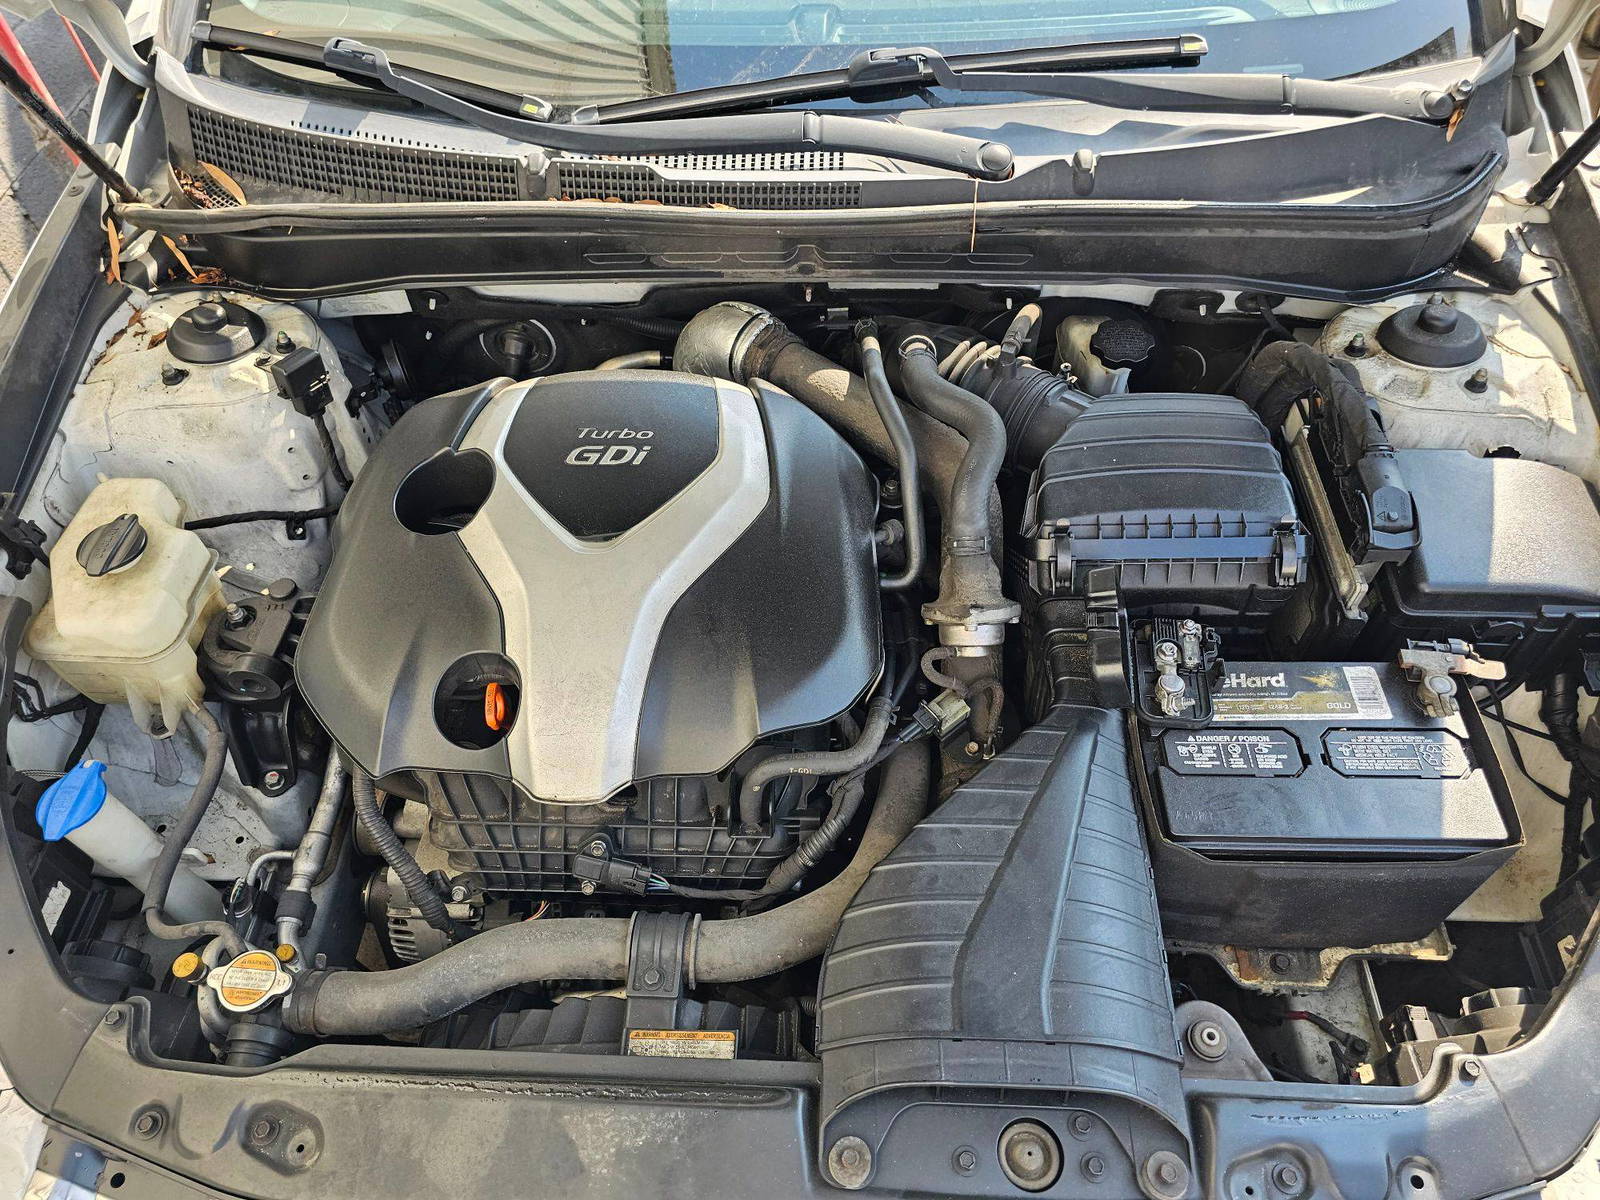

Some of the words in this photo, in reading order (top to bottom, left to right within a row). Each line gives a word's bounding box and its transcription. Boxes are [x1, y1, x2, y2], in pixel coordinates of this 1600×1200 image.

[577, 427, 655, 439] Turbo
[565, 445, 652, 465] GDi
[1326, 702, 1351, 710] GOLD
